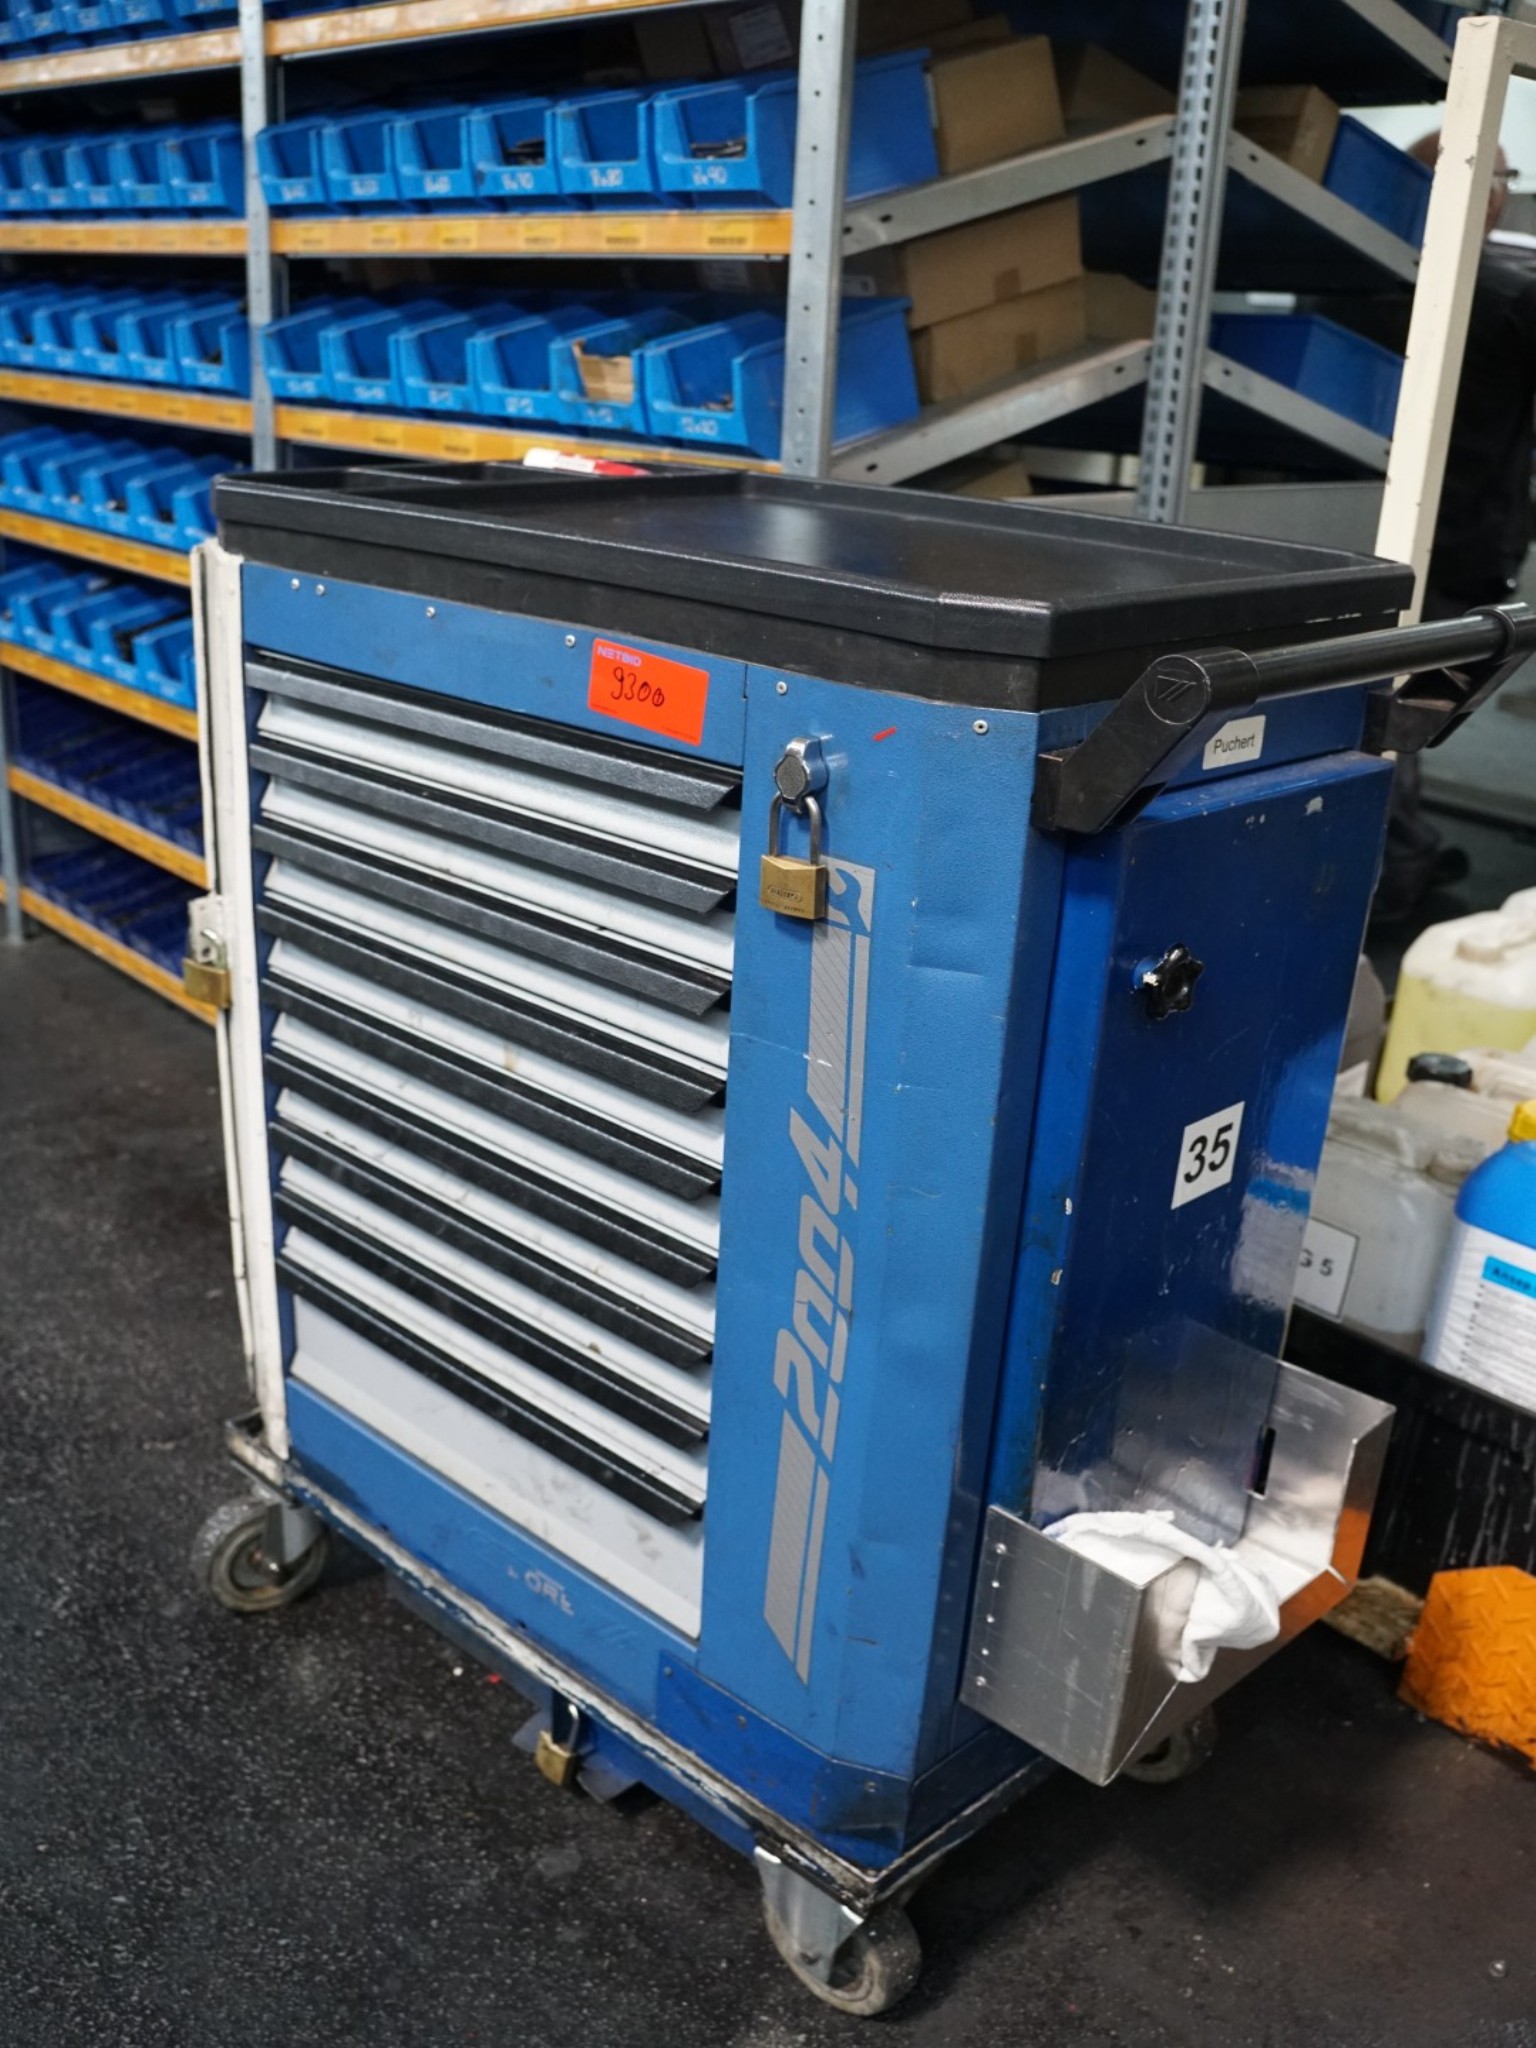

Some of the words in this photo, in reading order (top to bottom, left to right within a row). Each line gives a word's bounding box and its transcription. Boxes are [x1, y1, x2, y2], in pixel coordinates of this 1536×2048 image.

[597, 646, 642, 667] NETBID
[611, 666, 666, 707] 9300
[1212, 733, 1256, 755] Puchert
[1184, 1122, 1234, 1184] 35
[1319, 1257, 1334, 1277] 5
[773, 1106, 858, 1463] 2004
